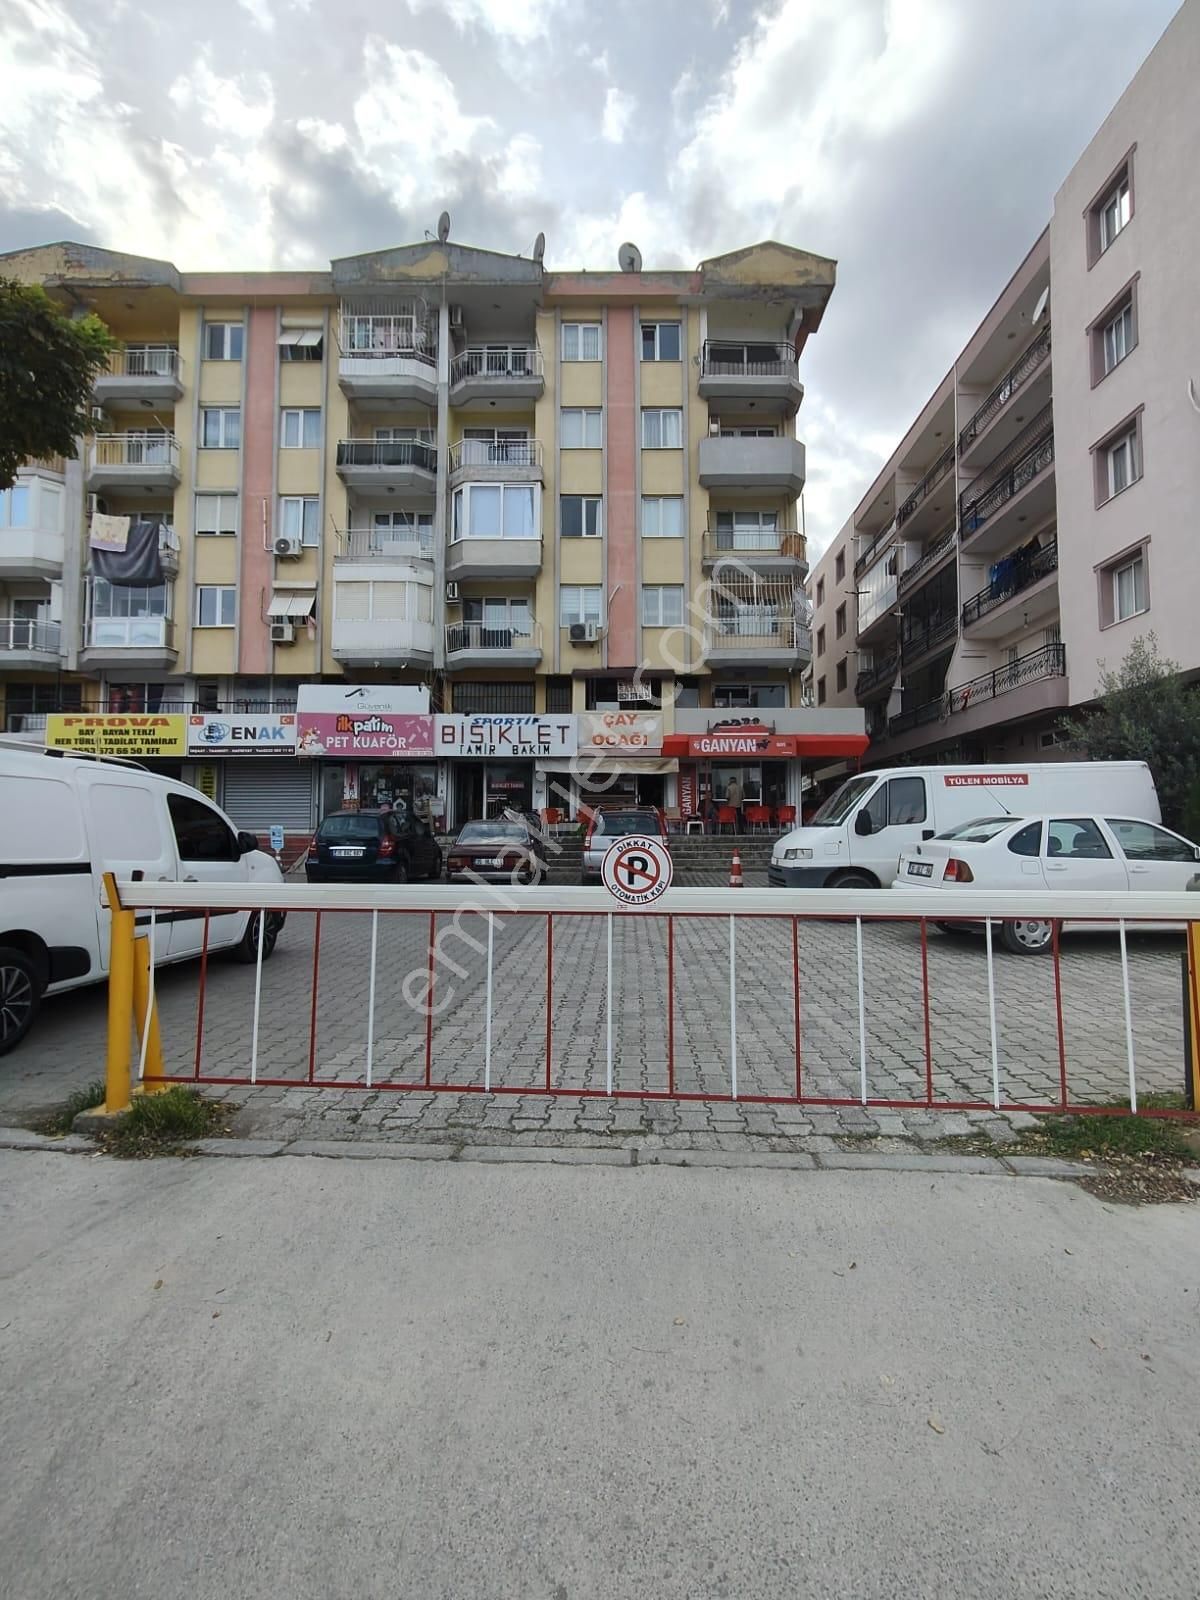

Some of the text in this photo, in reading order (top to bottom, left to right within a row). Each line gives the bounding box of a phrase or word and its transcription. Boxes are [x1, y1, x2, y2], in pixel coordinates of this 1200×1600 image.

[63, 717, 170, 727] PROVA
[471, 716, 541, 726] SPORTİF
[603, 713, 638, 728] ÇAY
[78, 727, 155, 736] BAY BAYAN TERZİ
[231, 726, 285, 740] ENAK
[55, 737, 72, 745] HER
[104, 737, 138, 745] TADİLAT
[140, 736, 177, 745] TAMİRAT
[326, 734, 407, 748] PET KUAFÖR
[591, 732, 648, 746] OCAĞI
[700, 738, 757, 753] GANYAN
[459, 743, 550, 755] TAMİR BAKIM
[948, 775, 1025, 785] TÜLEN MOBİLYA
[681, 776, 692, 815] GANYAN
[616, 840, 653, 853] DİKKAT
[627, 856, 649, 885] P
[610, 880, 666, 902] OTOMATİK KAPI
